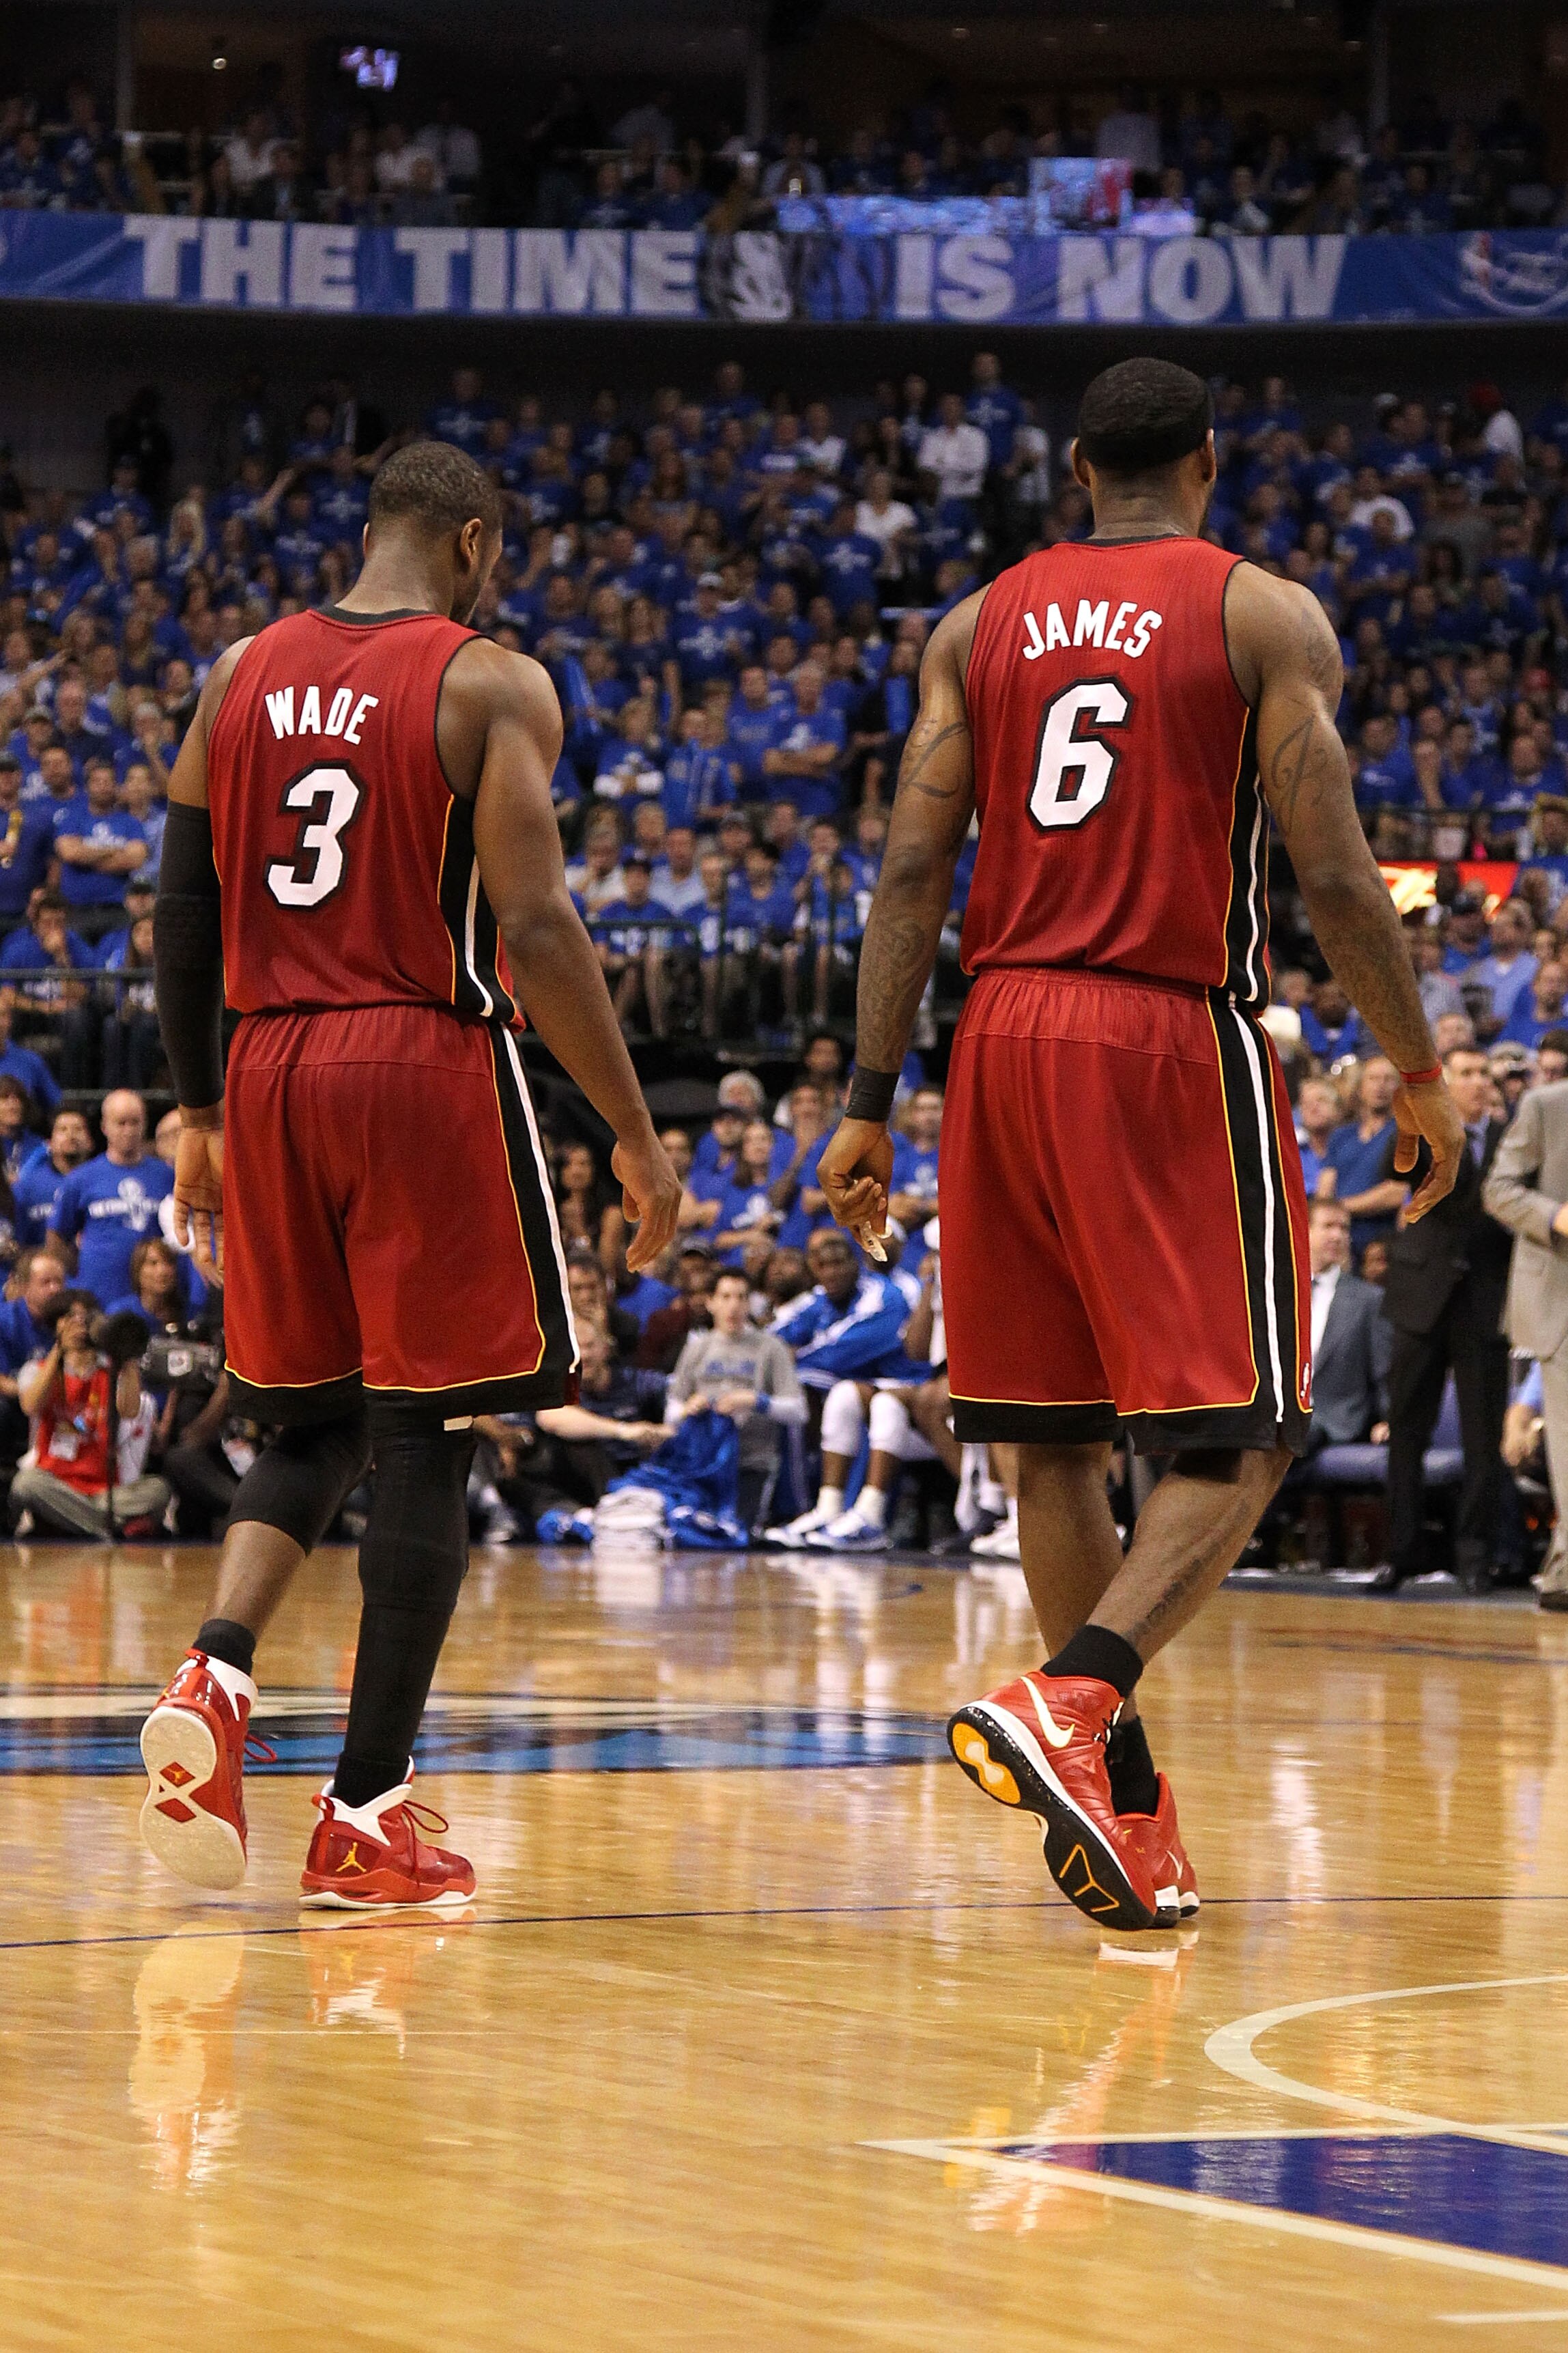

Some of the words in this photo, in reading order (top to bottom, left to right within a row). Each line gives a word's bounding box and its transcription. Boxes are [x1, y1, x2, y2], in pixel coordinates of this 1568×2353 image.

[123, 212, 358, 311] THE
[394, 227, 700, 315] TIME
[894, 234, 1016, 321] IS
[1057, 234, 1349, 323] NOW
[1022, 598, 1163, 661] JAMES
[264, 685, 380, 745] WADE
[1029, 682, 1128, 828] 6
[267, 768, 360, 906] 3
